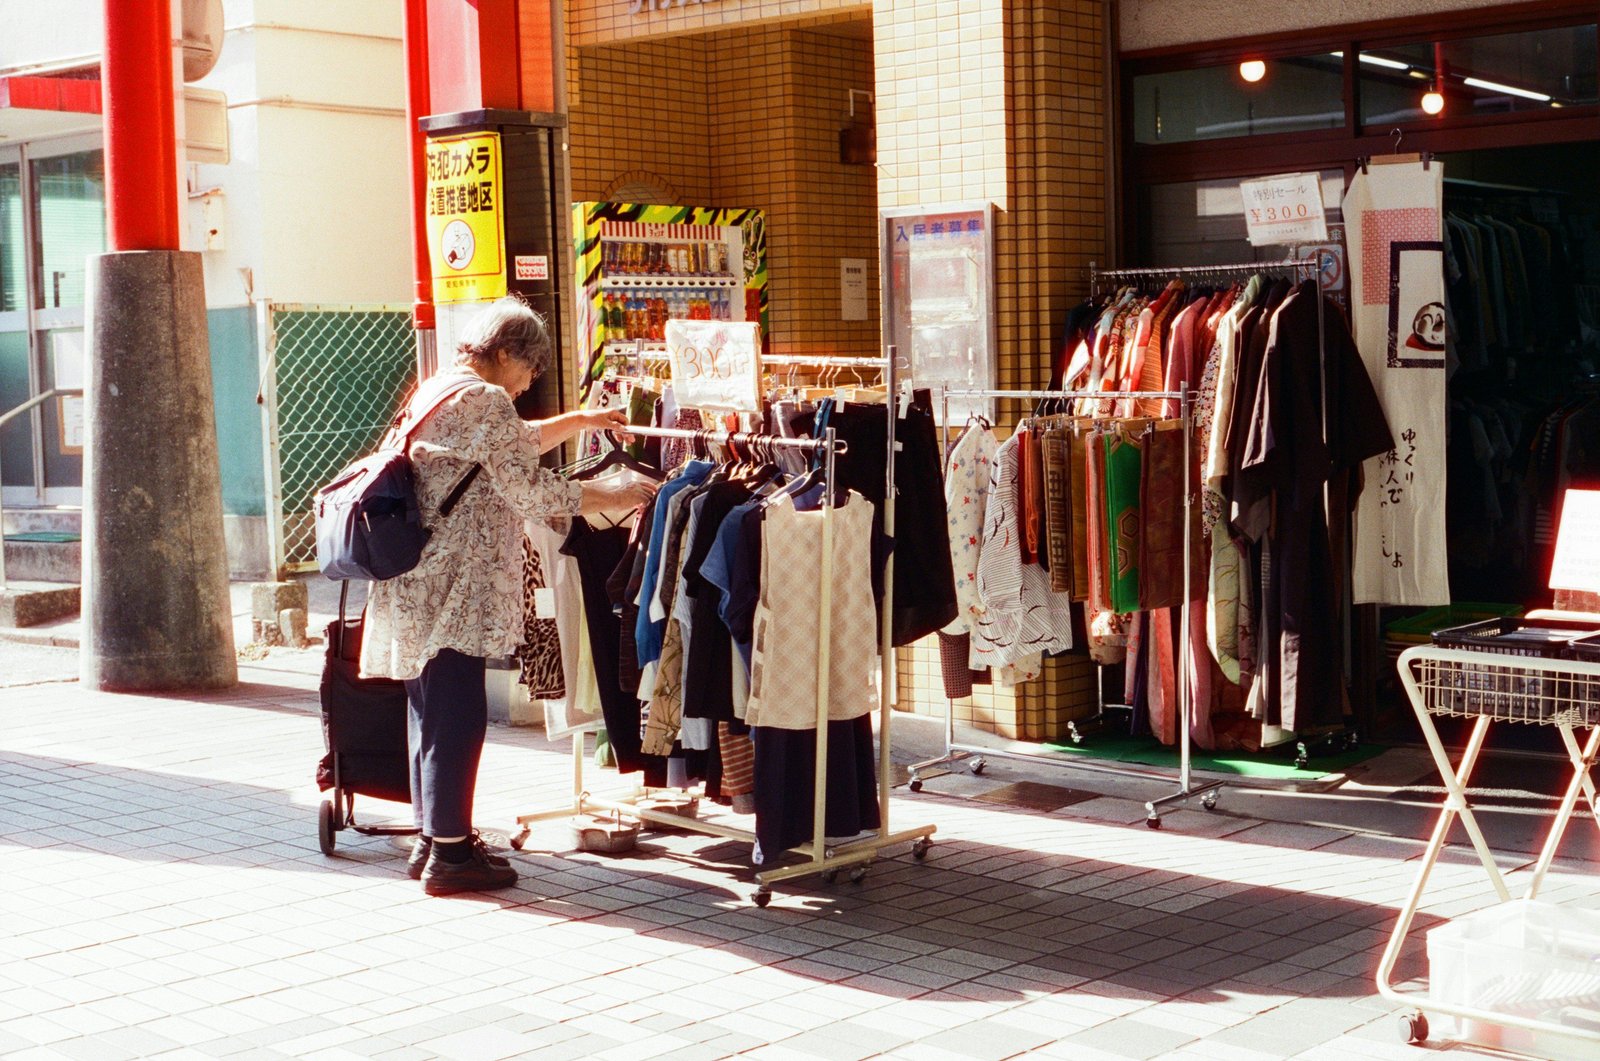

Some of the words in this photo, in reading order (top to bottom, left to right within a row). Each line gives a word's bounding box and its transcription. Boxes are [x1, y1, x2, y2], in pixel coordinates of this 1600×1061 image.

[895, 219, 981, 242] 入居者募集
[1401, 428, 1416, 484] ゆっくり
